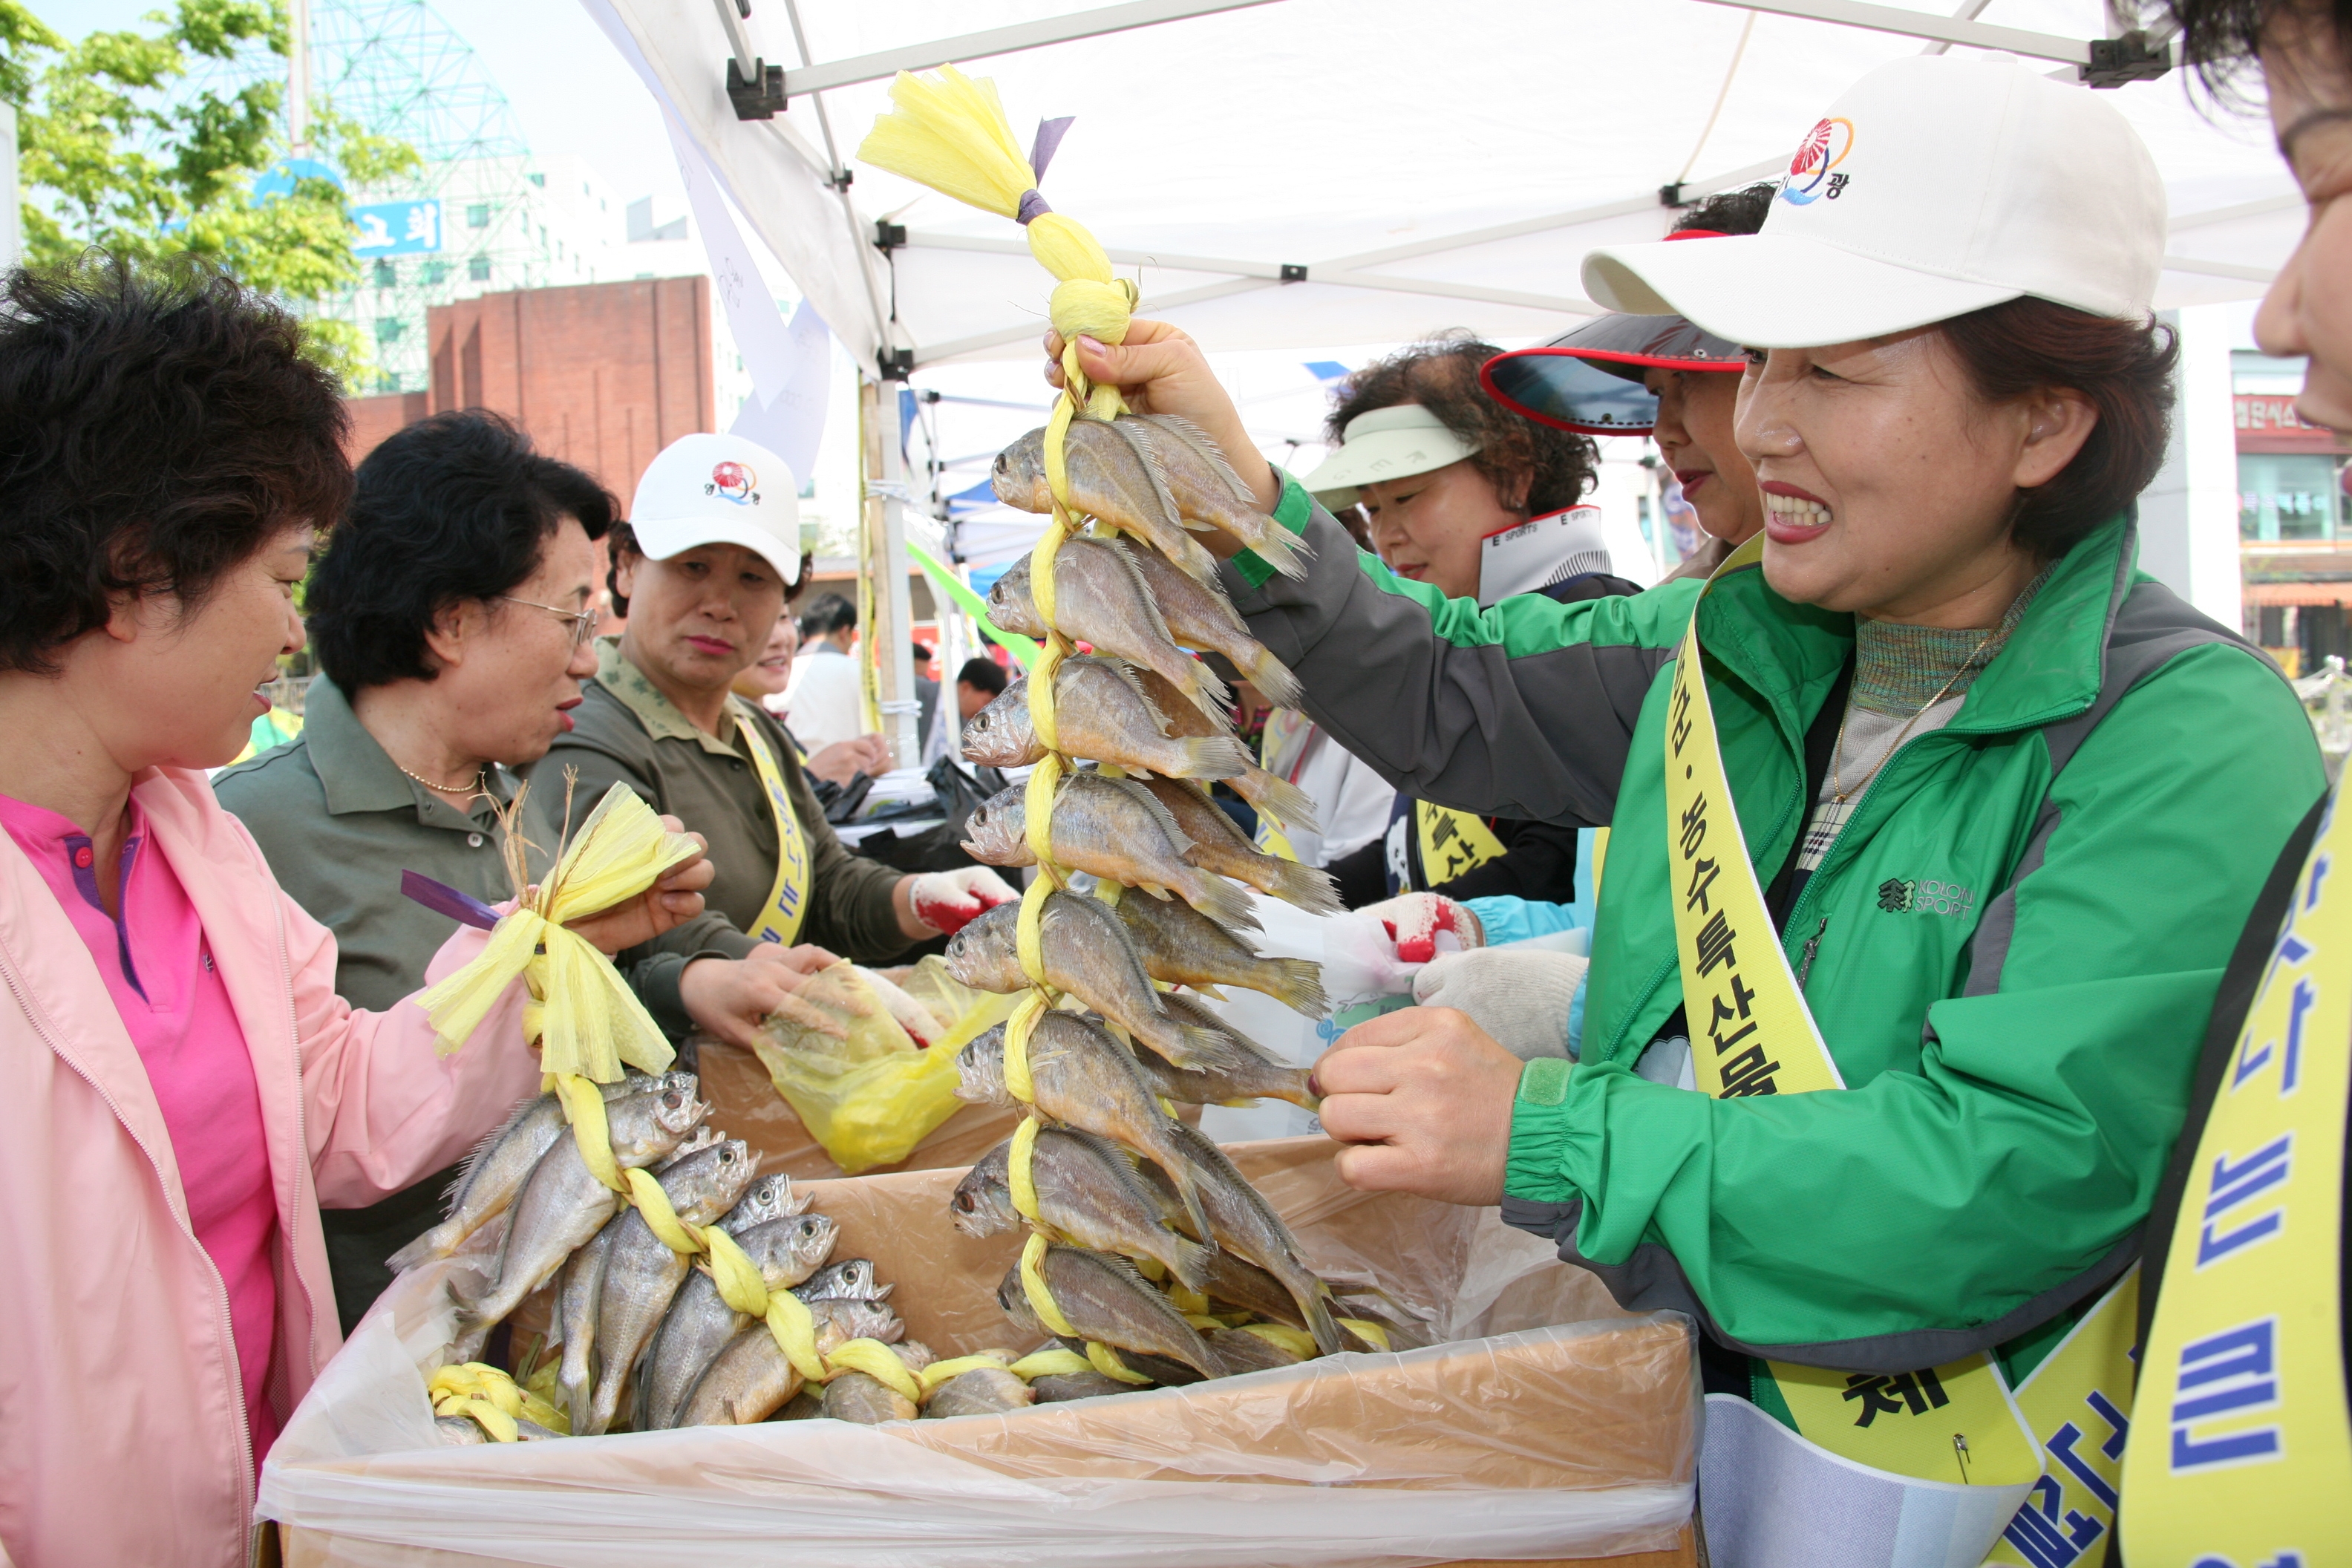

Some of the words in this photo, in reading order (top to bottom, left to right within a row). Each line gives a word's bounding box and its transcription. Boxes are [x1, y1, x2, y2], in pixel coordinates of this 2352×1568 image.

[1826, 172, 1851, 200] 광
[1505, 523, 1538, 541] SPORTS
[1918, 879, 1975, 905] KOLON
[1915, 895, 1973, 921] SPORT
